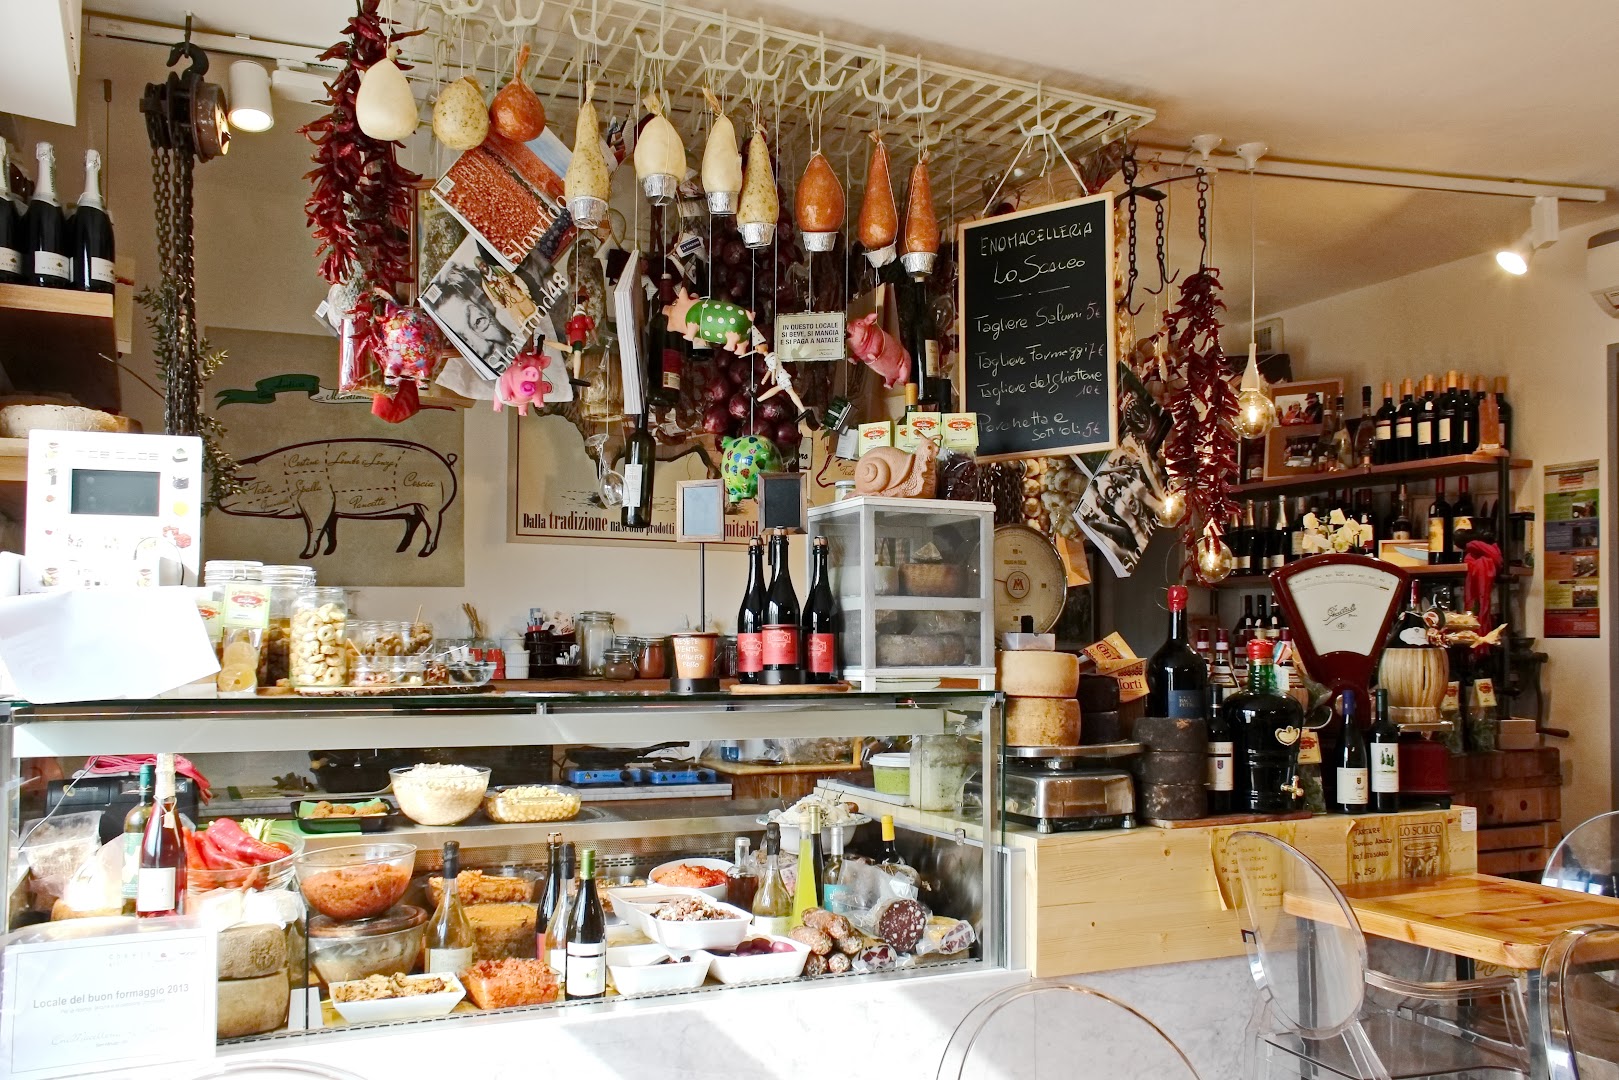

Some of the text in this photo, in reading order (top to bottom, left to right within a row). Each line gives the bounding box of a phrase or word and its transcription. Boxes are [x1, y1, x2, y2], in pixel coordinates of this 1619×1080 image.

[993, 261, 1018, 284] Lo
[790, 323, 814, 331] QUESTO
[973, 314, 1028, 341] Tagliere
[1035, 302, 1082, 327] Salumi
[974, 352, 1027, 377] Tagliere
[1025, 342, 1088, 362] Formaggi
[977, 380, 1027, 406] Tagliere
[977, 410, 1049, 433] Porchetta
[523, 512, 546, 529] Dalla
[549, 510, 608, 532] tradizione
[1399, 824, 1441, 837] LO SCALCO
[33, 996, 68, 1009] Locale
[69, 993, 86, 1005] del
[88, 991, 114, 1003] buon
[115, 986, 165, 1002] formaggio
[167, 983, 189, 995] 2013
